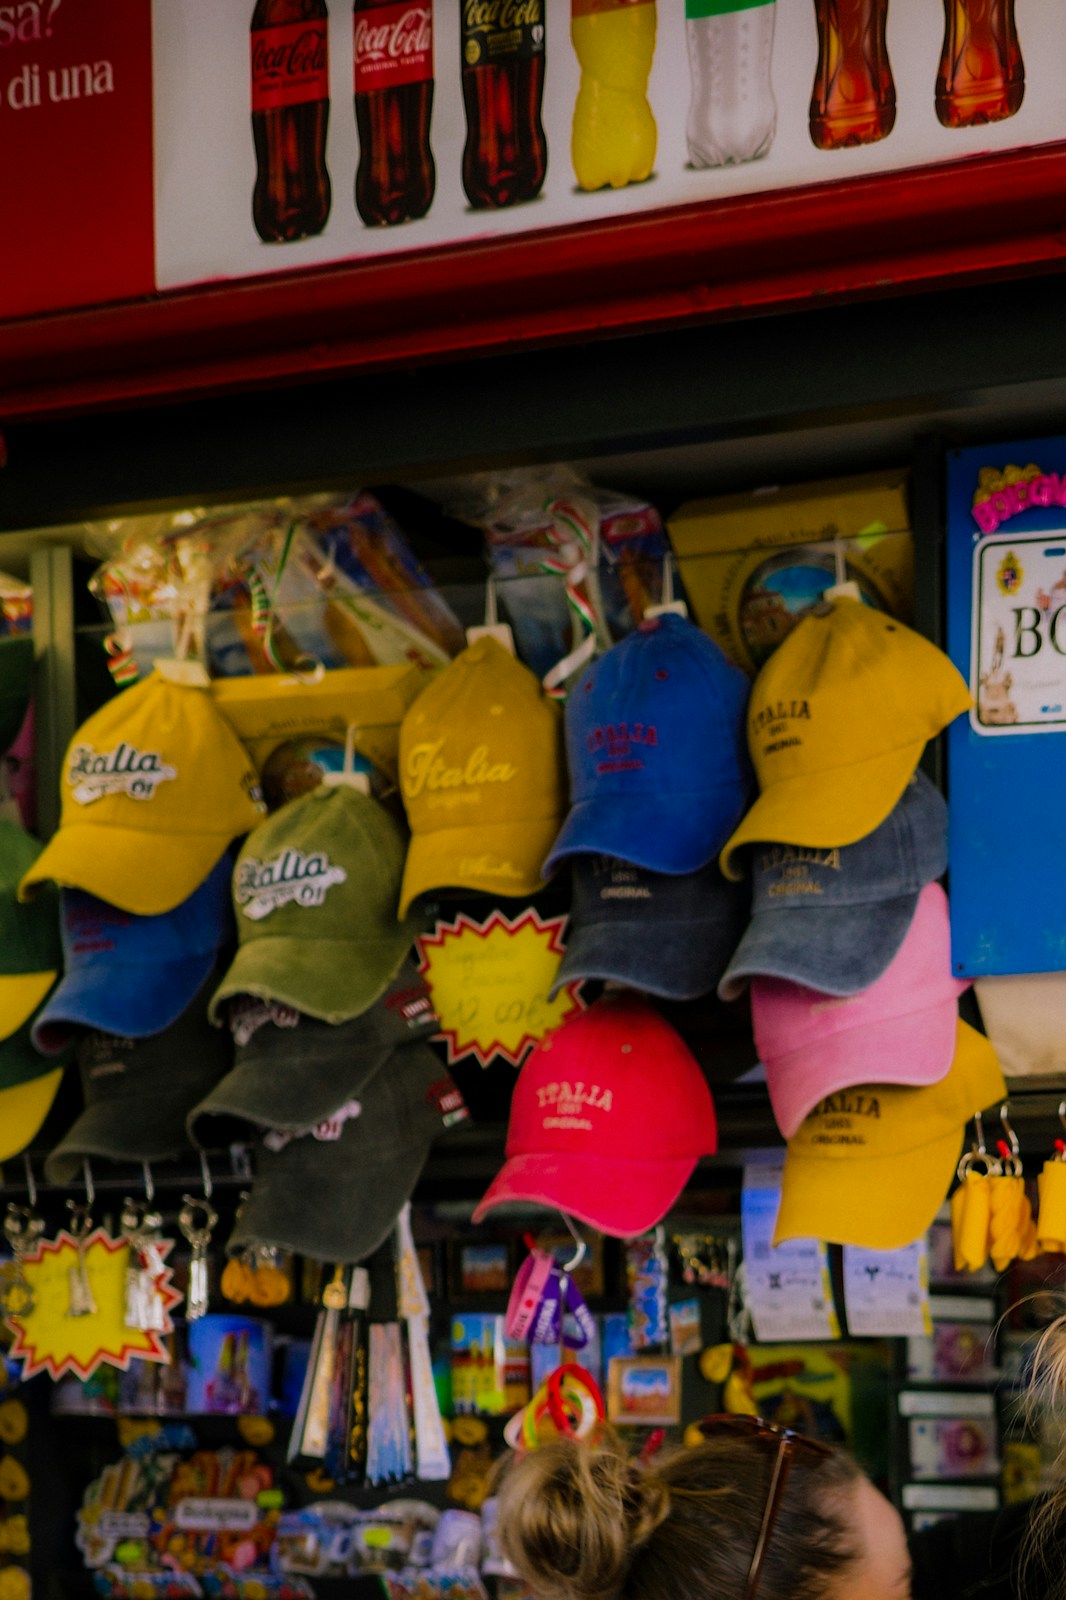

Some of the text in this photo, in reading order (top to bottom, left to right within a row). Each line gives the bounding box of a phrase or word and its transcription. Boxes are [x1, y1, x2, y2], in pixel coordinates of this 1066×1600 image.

[8, 60, 114, 110] di una
[406, 736, 517, 798] Italia
[537, 1082, 613, 1112] ITALIA
[805, 1093, 882, 1119] TALIA
